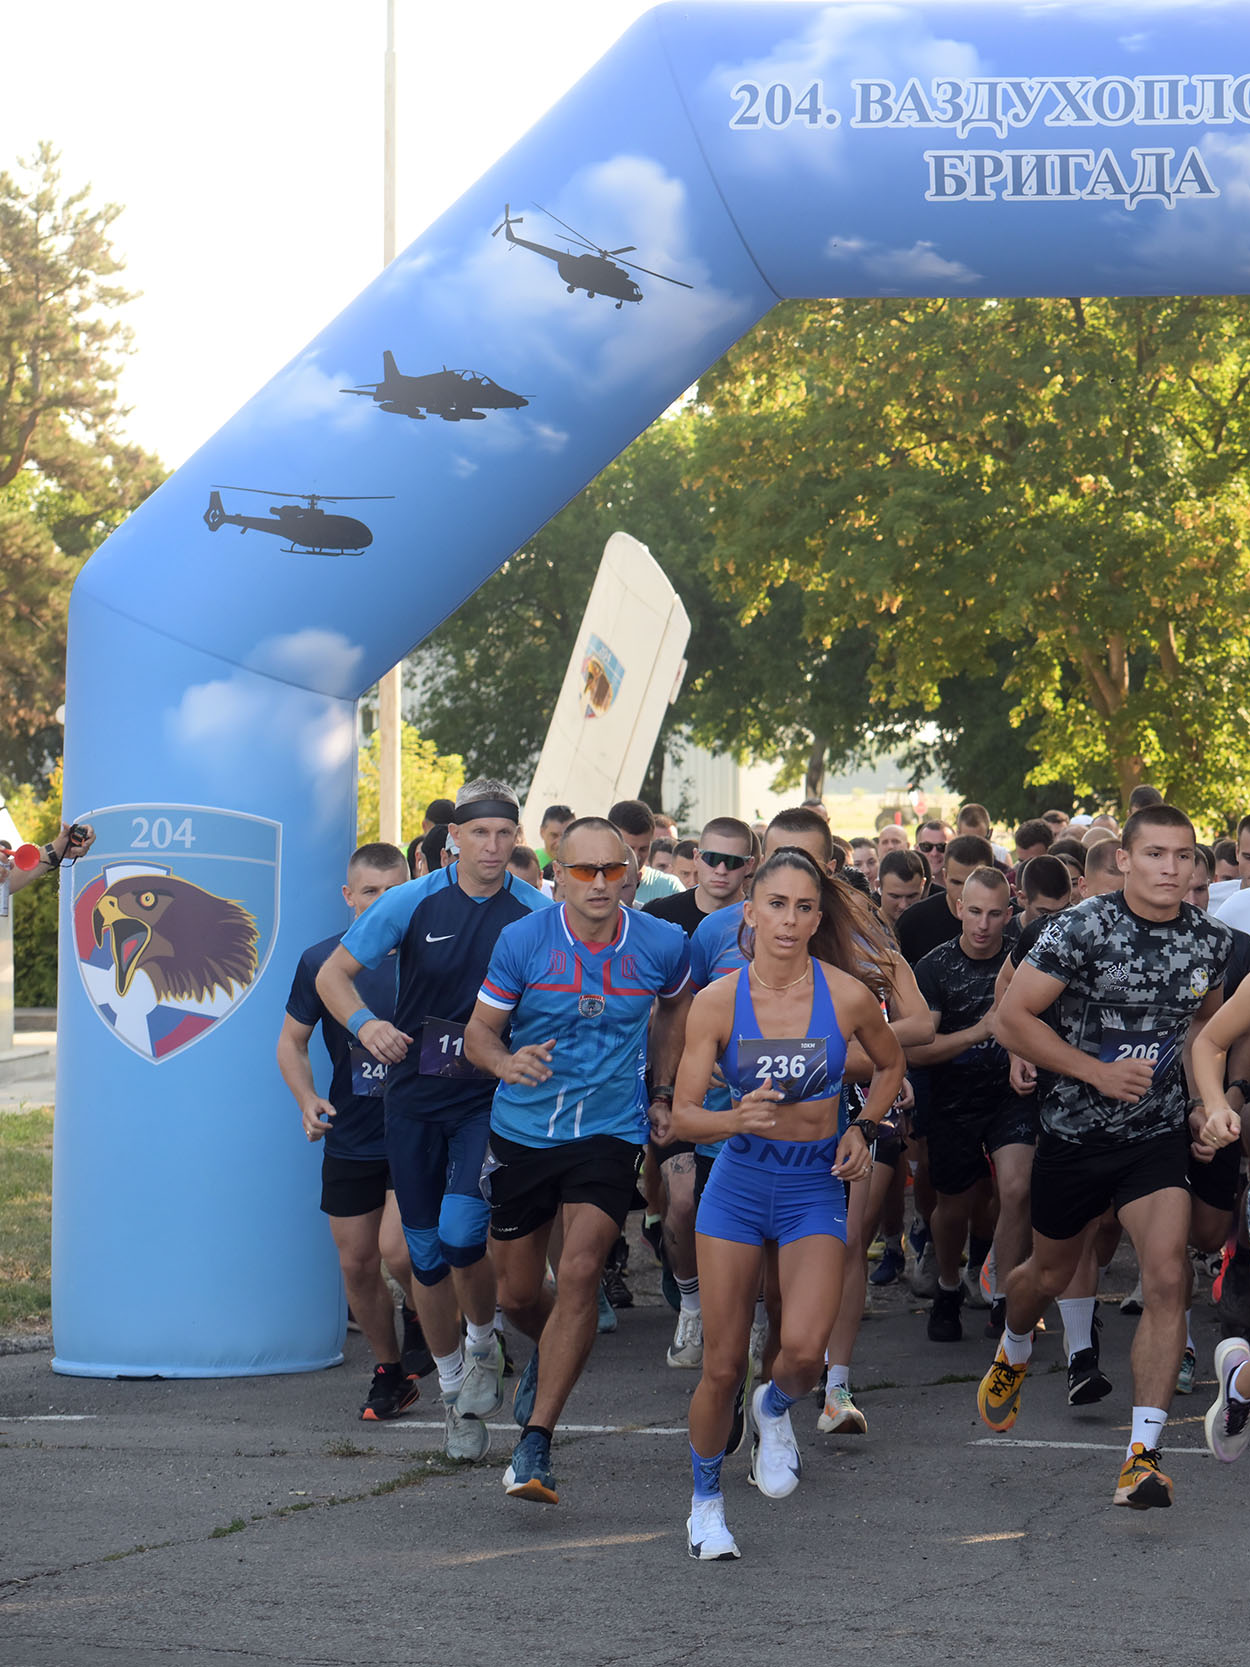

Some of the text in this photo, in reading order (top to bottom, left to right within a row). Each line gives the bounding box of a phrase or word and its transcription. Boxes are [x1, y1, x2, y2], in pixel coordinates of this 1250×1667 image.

[729, 80, 842, 130] 204.
[923, 147, 1221, 210] БРИГАДА
[130, 816, 197, 849] 204
[439, 1034, 464, 1056] 11
[1114, 1042, 1160, 1063] 206
[361, 1061, 388, 1080] 24
[755, 1054, 806, 1079] 236
[757, 1141, 836, 1168] NIK
